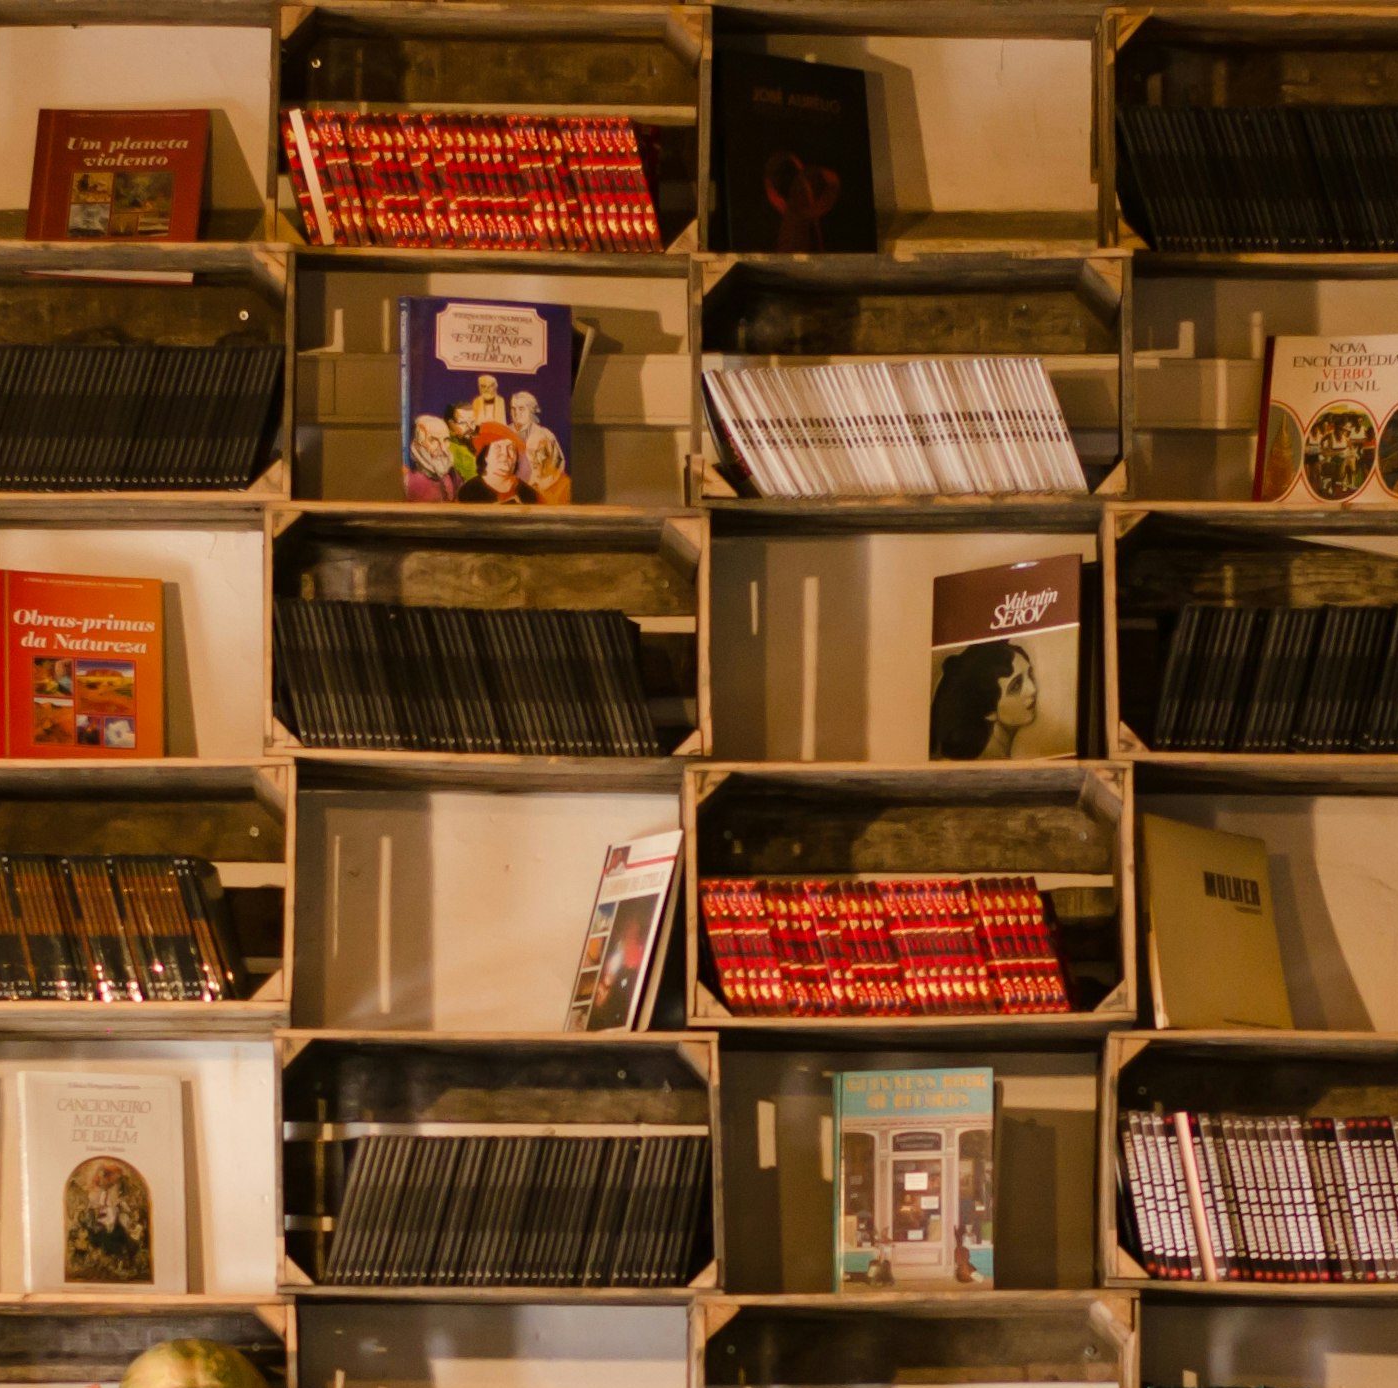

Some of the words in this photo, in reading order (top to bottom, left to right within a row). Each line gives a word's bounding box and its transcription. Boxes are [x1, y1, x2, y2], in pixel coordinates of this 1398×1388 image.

[66, 137, 106, 150] Um
[110, 136, 189, 154] planeta
[84, 153, 169, 167] violento
[1329, 343, 1367, 355] NOVA
[1323, 367, 1372, 380] VERBO
[1311, 380, 1380, 394] JUVENIL
[1003, 587, 1058, 609] Valentin
[13, 608, 155, 634] Obras-primas
[990, 602, 1050, 630] SEROV
[20, 631, 47, 648] da
[54, 633, 147, 655] Natureza
[1203, 871, 1261, 906] MULHER
[56, 1098, 152, 1114] CANCIONEIRO
[74, 1114, 137, 1129] MUSICAL
[72, 1129, 90, 1143] DE
